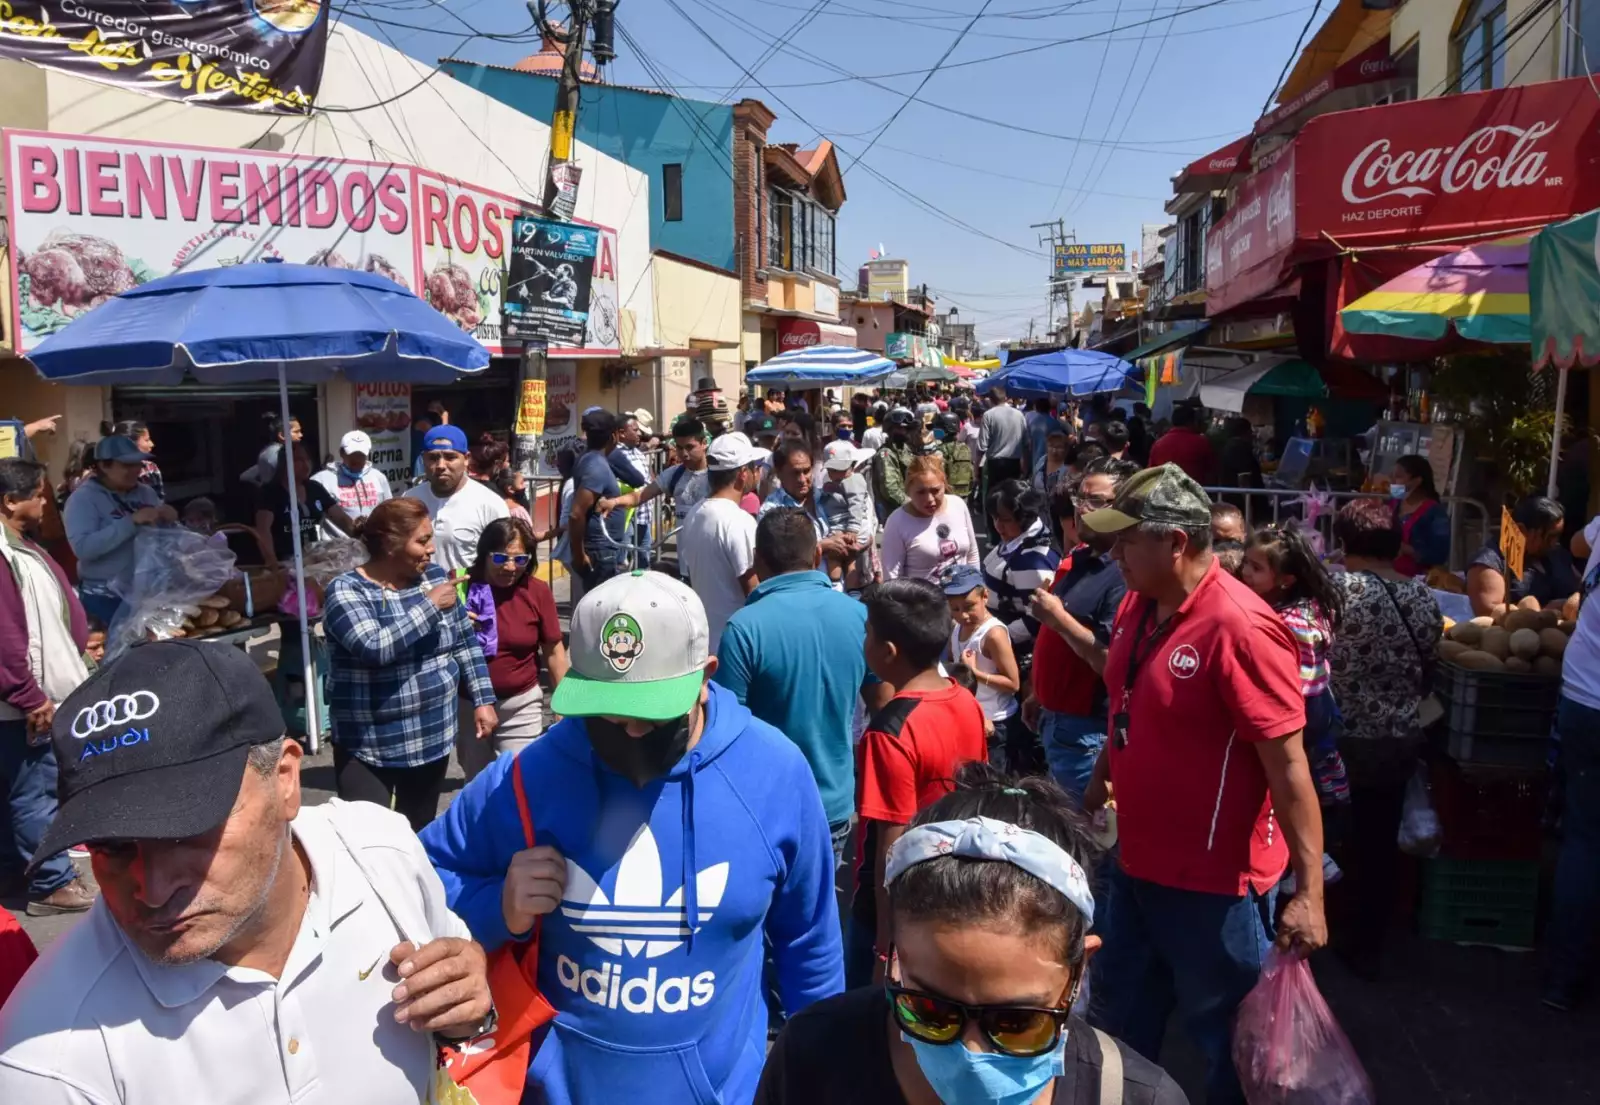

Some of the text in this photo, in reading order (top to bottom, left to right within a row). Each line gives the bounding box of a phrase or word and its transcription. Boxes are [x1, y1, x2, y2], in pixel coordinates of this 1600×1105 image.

[59, 0, 271, 71] Corredor gastronómico
[1342, 119, 1560, 204] Coca-Cola
[17, 144, 409, 235] BIENVENIDOS
[1544, 176, 1564, 187] MR
[1341, 205, 1423, 222] HAZ DEPORTE
[544, 249, 585, 263] VALVERDE
[1055, 244, 1124, 256] PLAYA BRUJA
[1056, 258, 1065, 267] EL
[1087, 256, 1124, 267] SABROSO
[782, 332, 818, 345] Coca-Cola
[1172, 651, 1197, 671] UP
[80, 727, 150, 762] AUDI
[556, 954, 716, 1014] adidas
